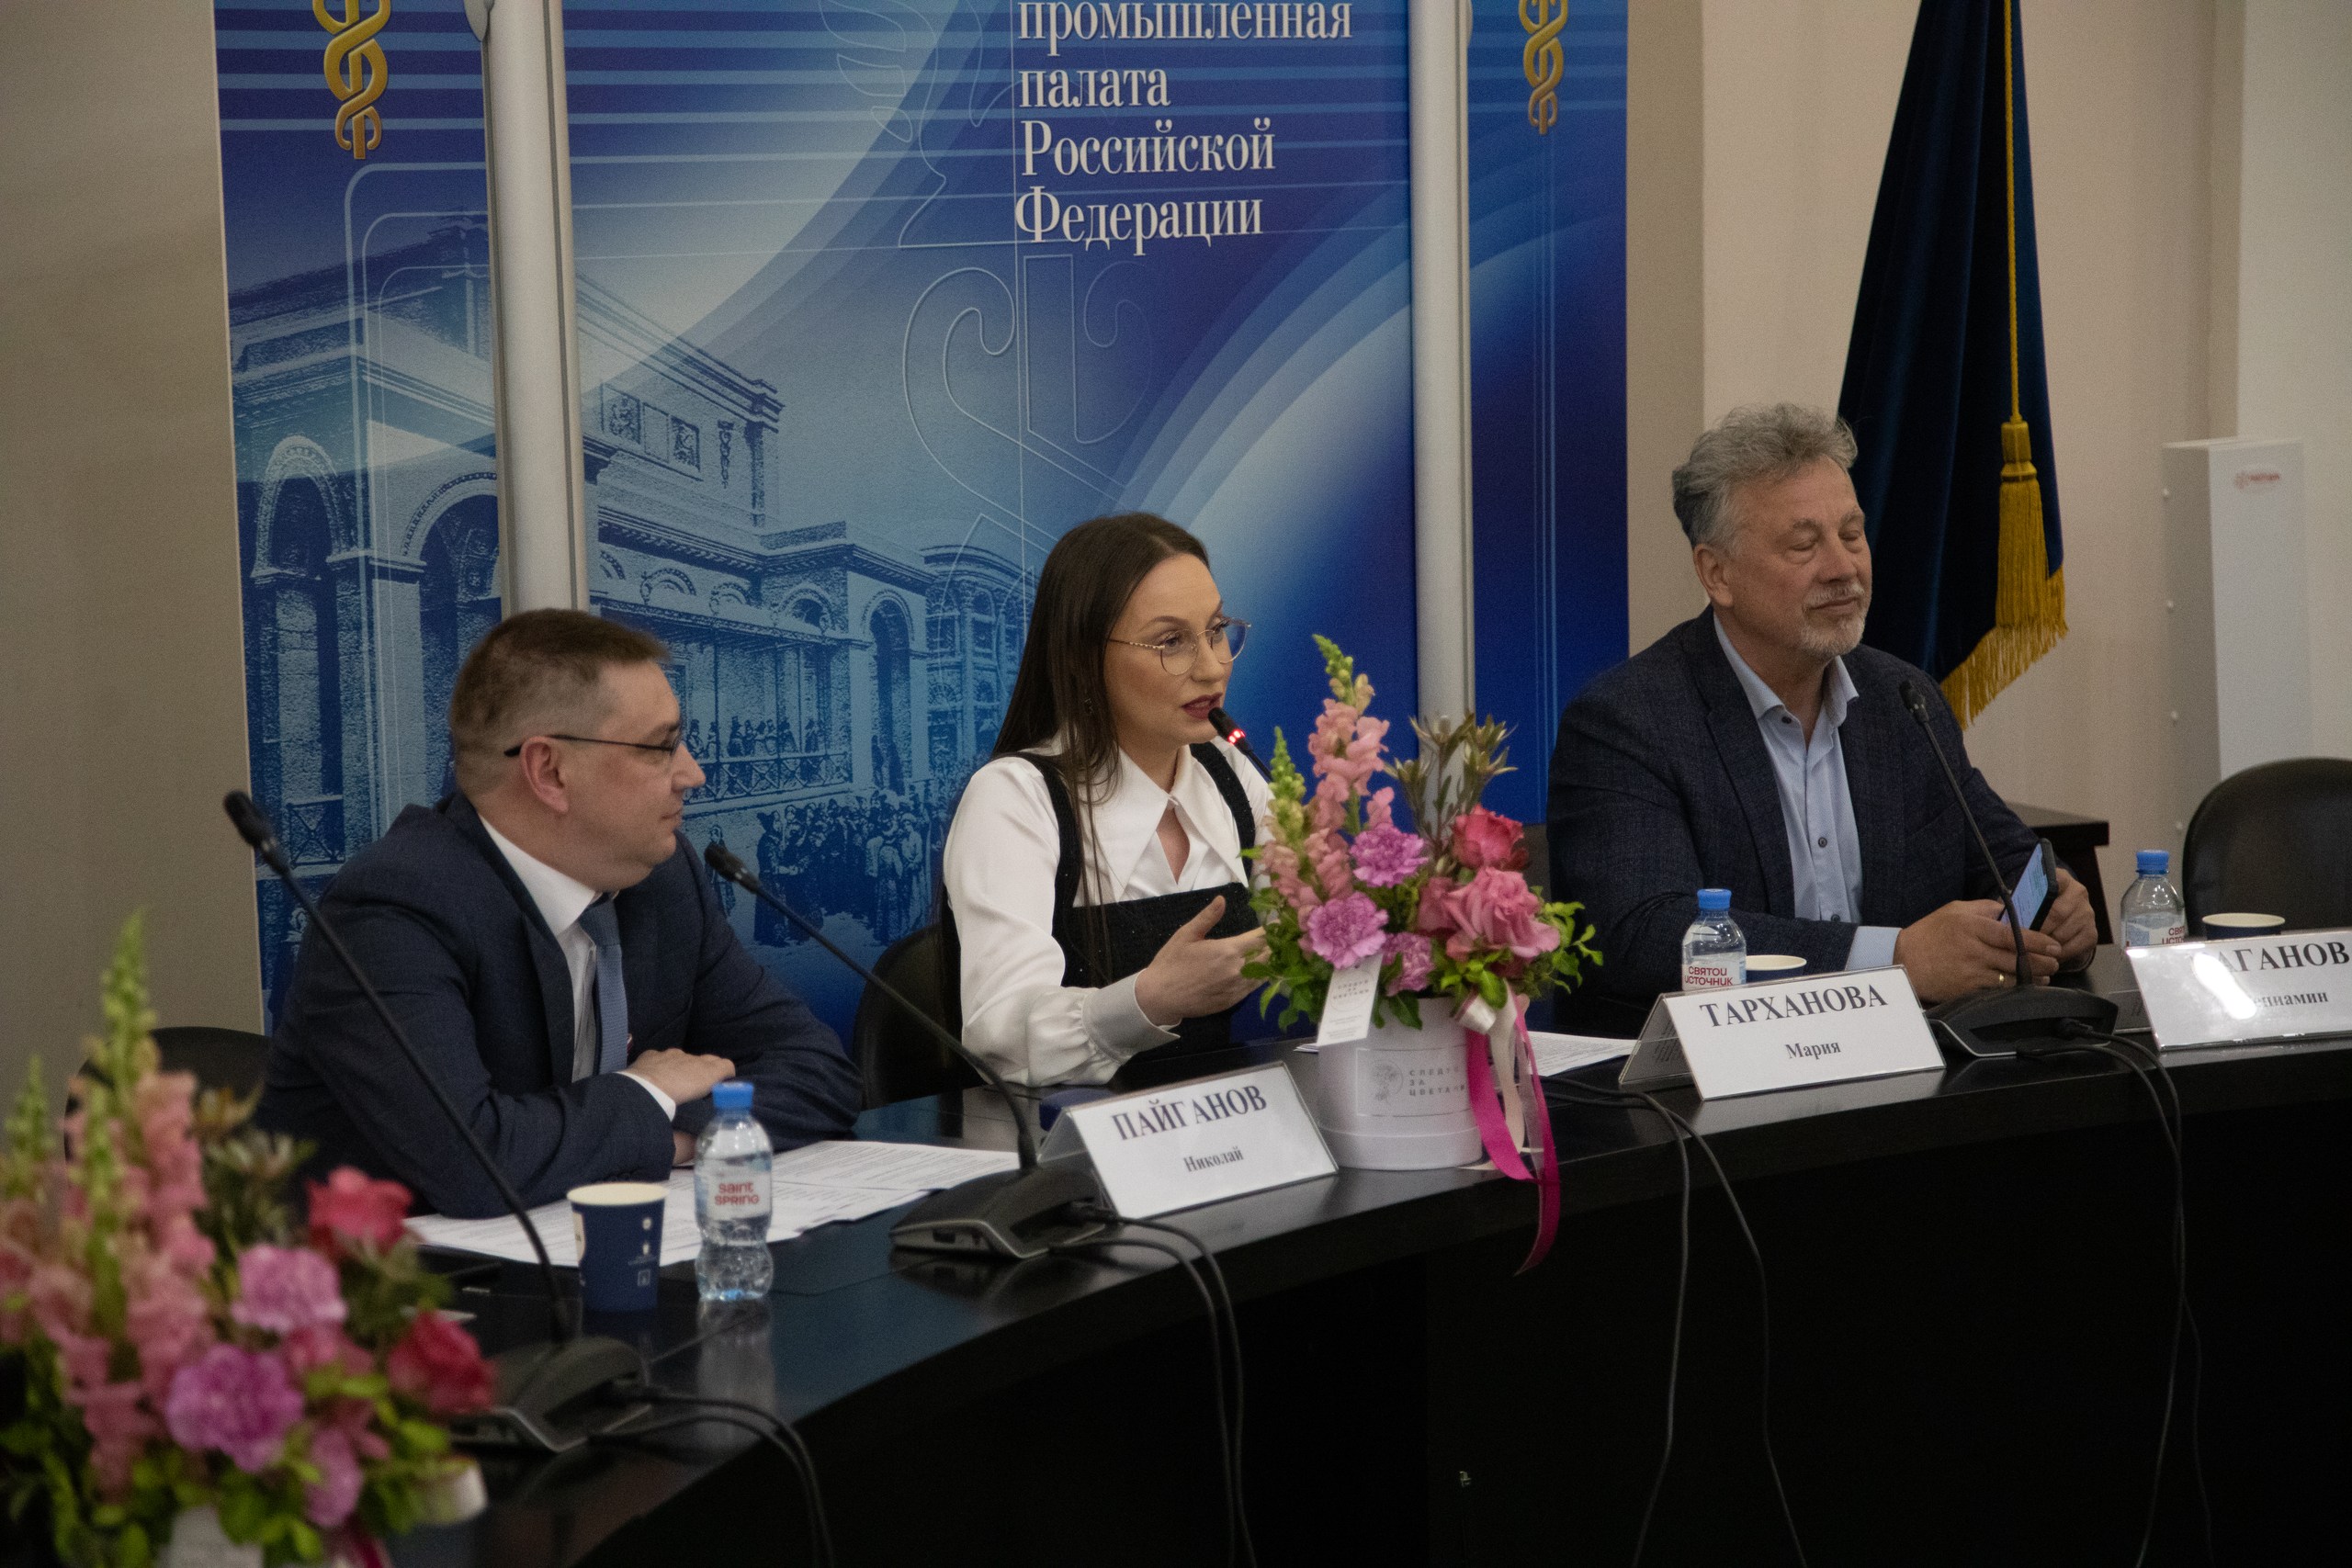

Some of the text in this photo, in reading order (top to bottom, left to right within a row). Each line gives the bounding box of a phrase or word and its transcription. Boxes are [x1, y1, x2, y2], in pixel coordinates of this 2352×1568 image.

[1018, 2, 1352, 56] промышленная
[1019, 69, 1170, 108] палата
[1020, 118, 1275, 176] Российской
[1014, 186, 1263, 255] Федерации
[2190, 942, 2349, 973] АГАНОВ
[1700, 984, 1888, 1027] ТАРХАНОВА
[2252, 992, 2328, 1008] ениамин
[1785, 1041, 1841, 1060] Мария
[1112, 1085, 1267, 1141] ПАЙГАНОВ
[1183, 1146, 1244, 1172] Николай
